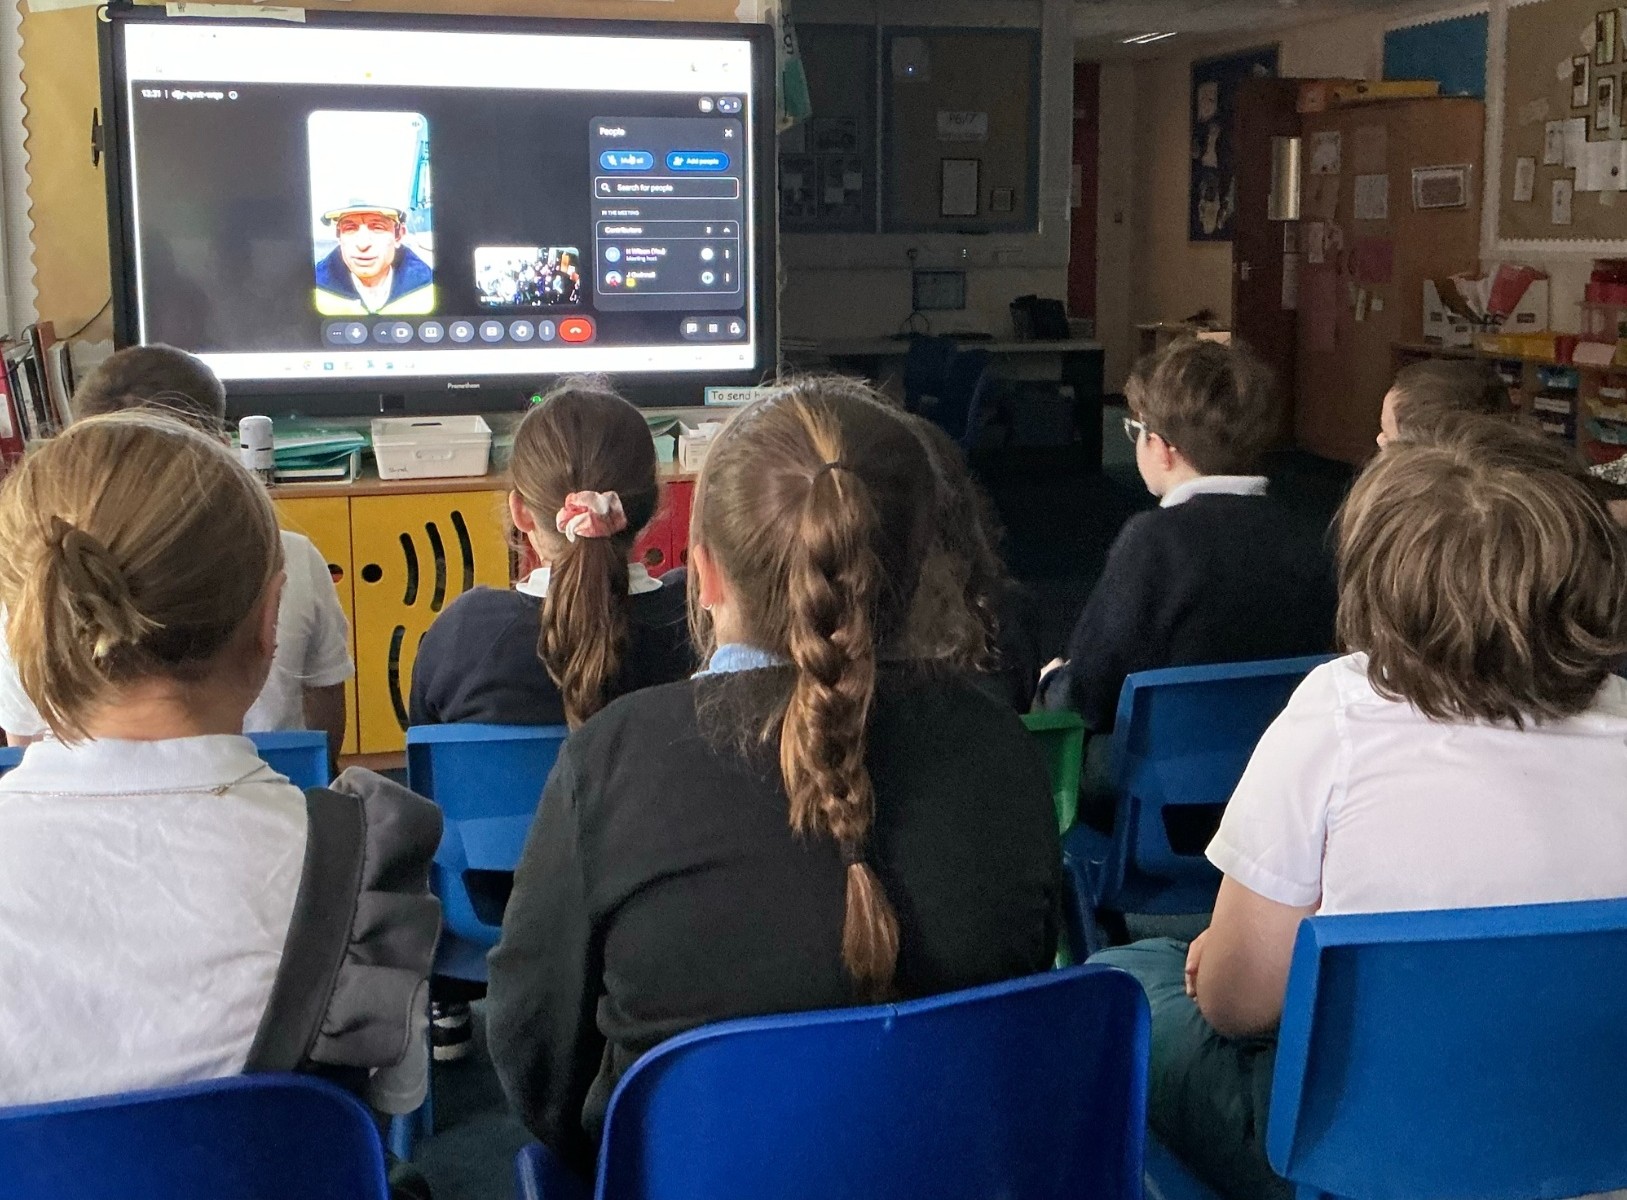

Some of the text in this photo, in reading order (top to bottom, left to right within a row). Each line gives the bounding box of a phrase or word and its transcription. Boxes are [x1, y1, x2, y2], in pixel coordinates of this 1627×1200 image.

[599, 126, 626, 137] People
[686, 157, 719, 166] Add people
[617, 184, 674, 193] Search for people
[604, 226, 643, 234] Contributors
[447, 381, 481, 389] Promethean
[711, 390, 724, 401] To
[727, 390, 751, 401] send
